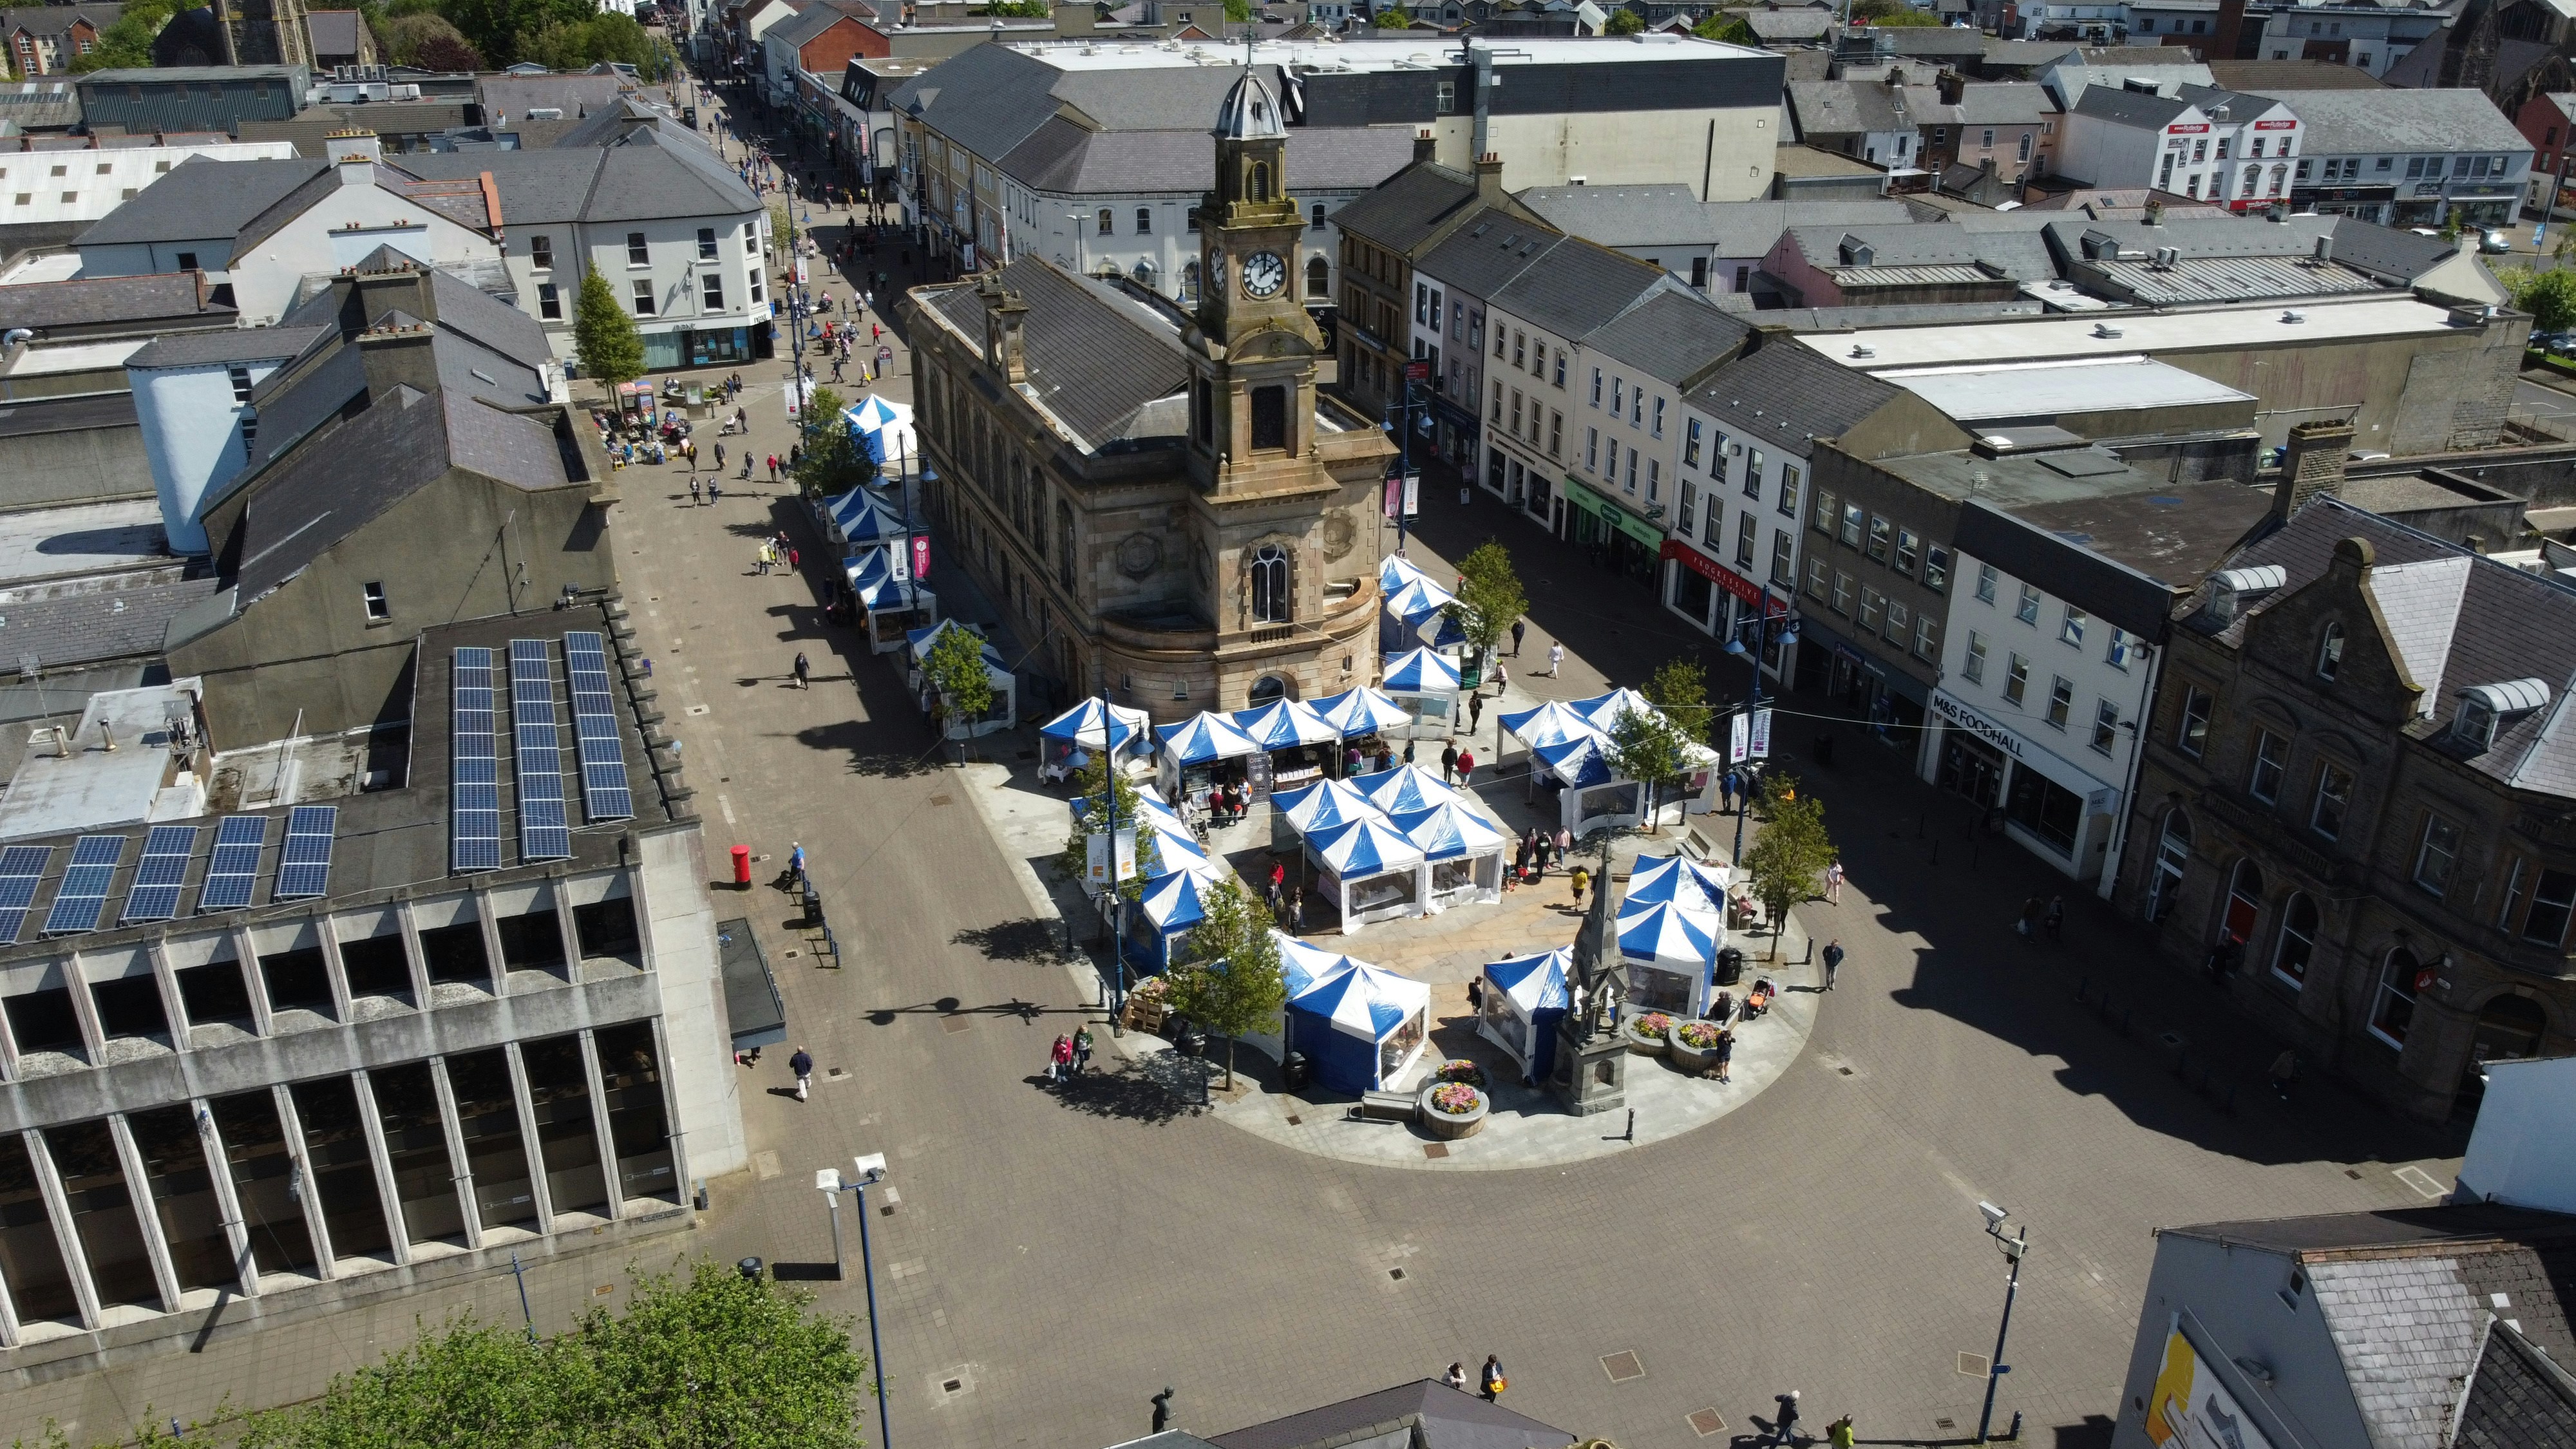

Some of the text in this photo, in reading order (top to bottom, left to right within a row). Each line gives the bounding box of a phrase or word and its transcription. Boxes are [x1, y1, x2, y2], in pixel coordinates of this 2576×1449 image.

[1694, 556, 1757, 600] PROGRESSIVE
[1934, 696, 2023, 757] M&S FOODHALL
